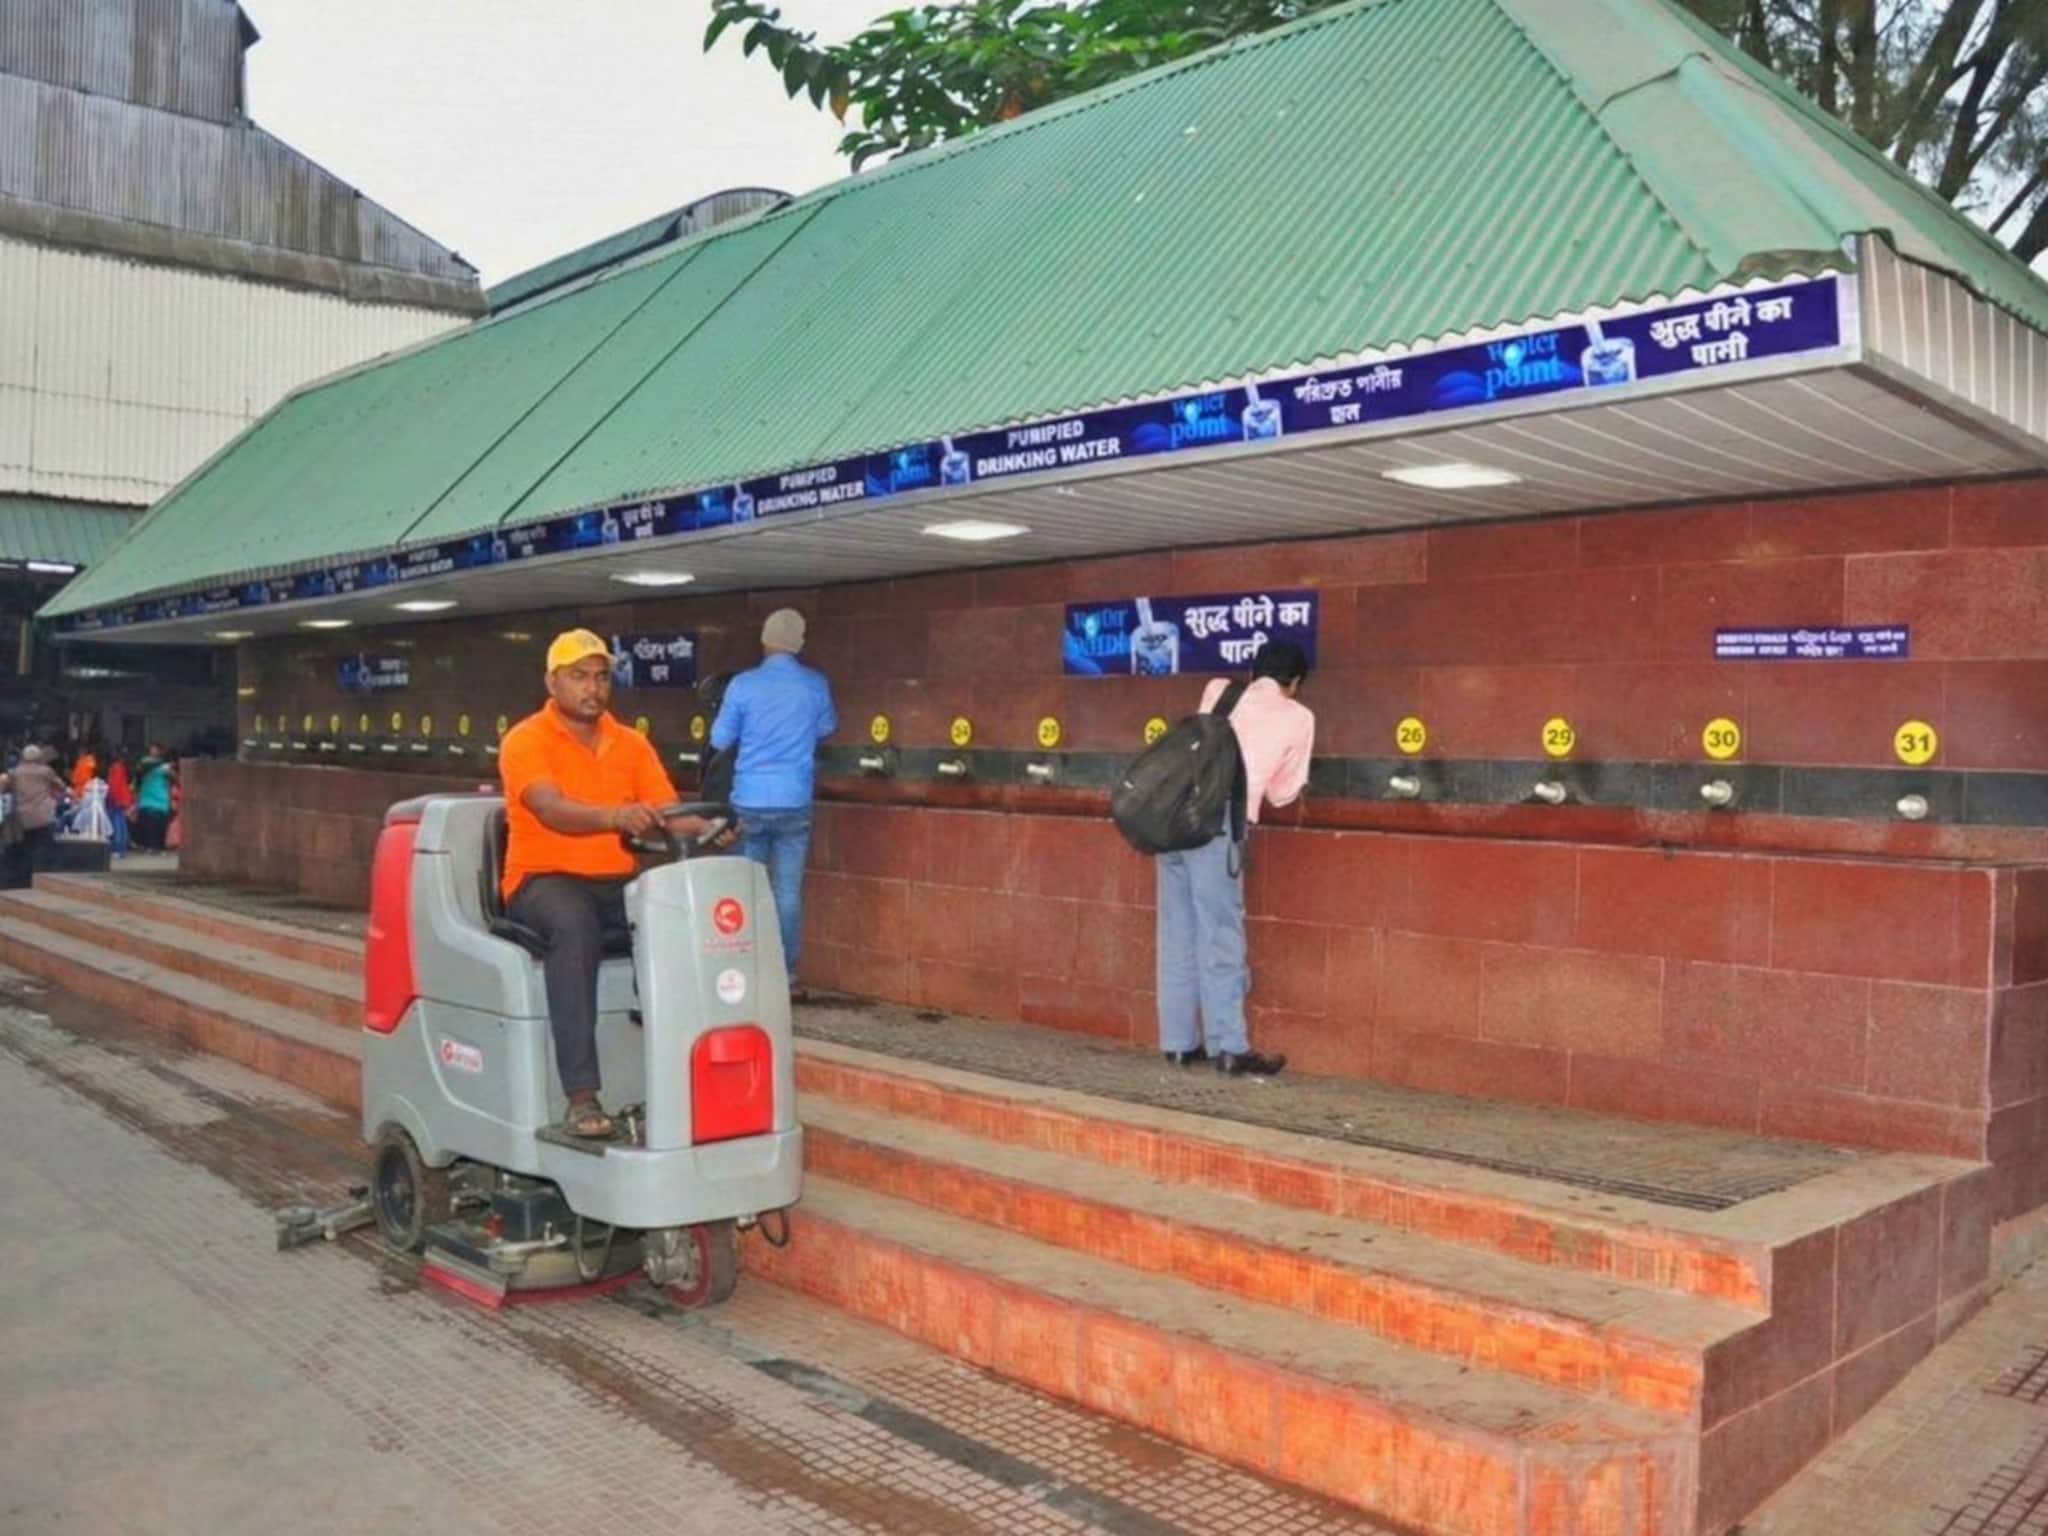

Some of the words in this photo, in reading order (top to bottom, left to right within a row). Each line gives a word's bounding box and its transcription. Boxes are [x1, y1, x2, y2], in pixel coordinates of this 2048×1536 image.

[977, 448, 1057, 476] DRINKING
[1060, 437, 1120, 463] WATER
[1185, 607, 1231, 638] शुद्ध
[1233, 594, 1275, 628] पीने
[1279, 601, 1311, 627] का
[1547, 729, 1571, 746] 29
[1707, 730, 1736, 748] 30
[1901, 731, 1930, 753] 31
